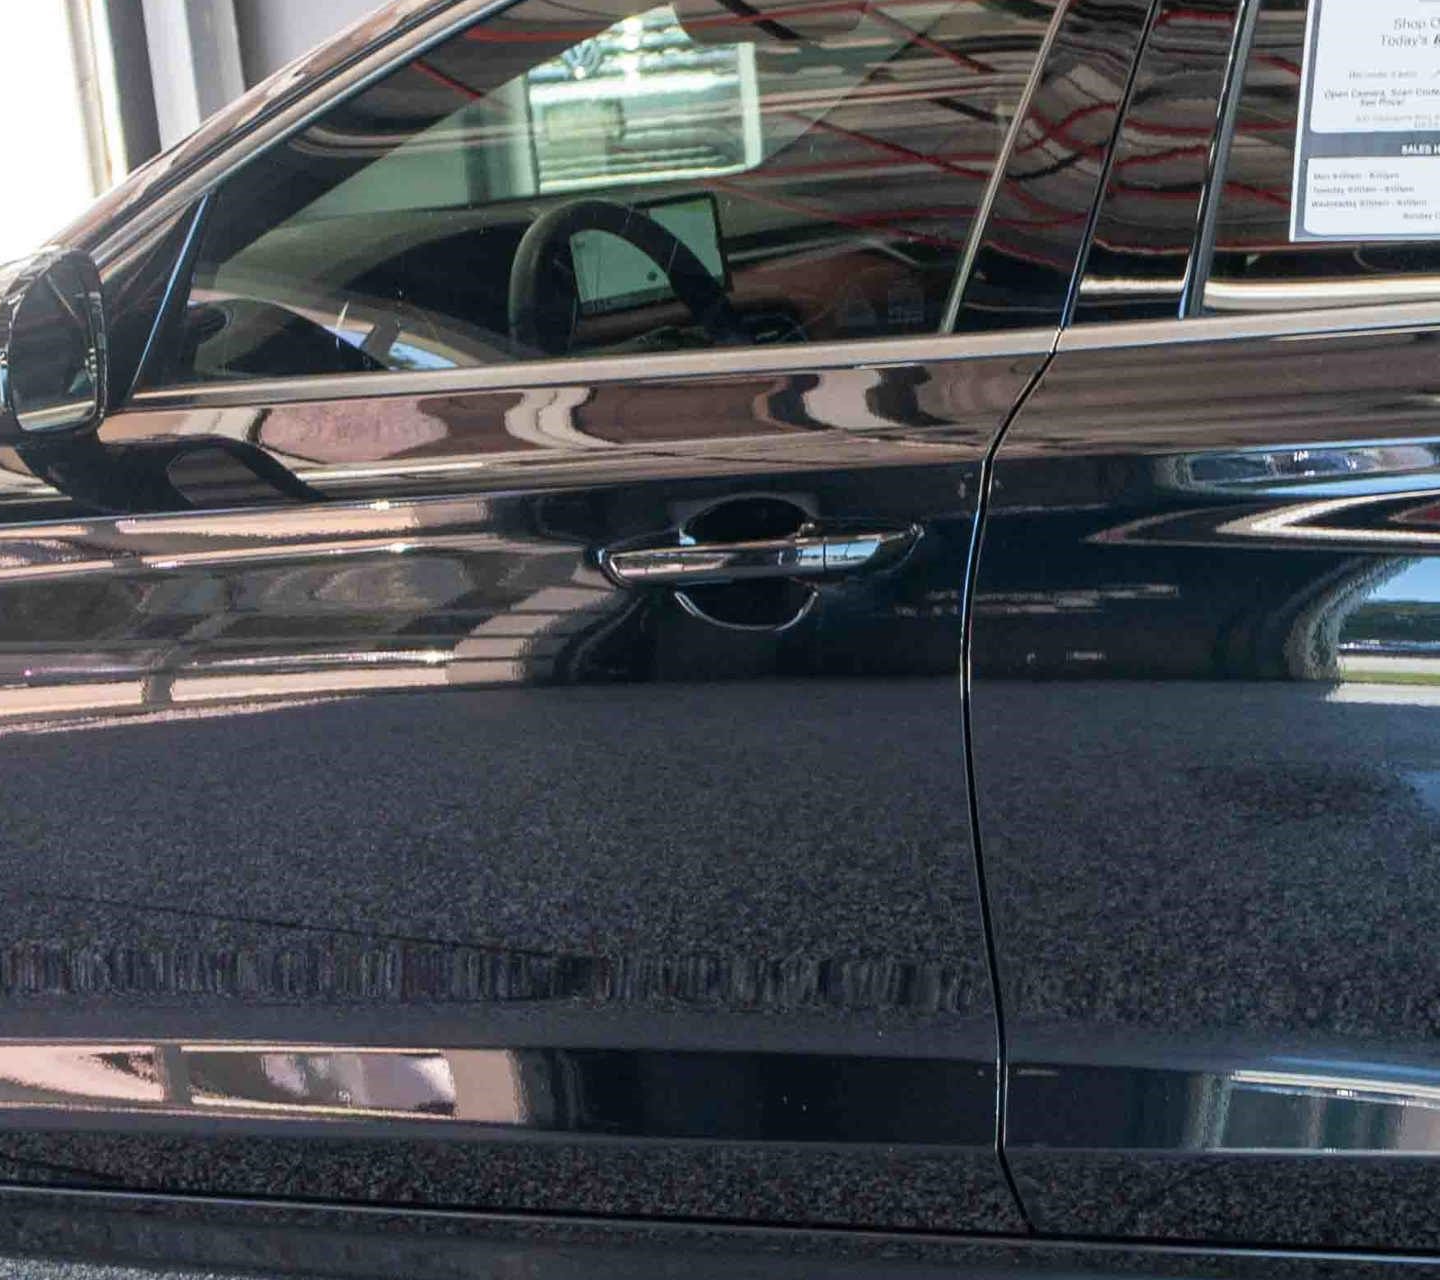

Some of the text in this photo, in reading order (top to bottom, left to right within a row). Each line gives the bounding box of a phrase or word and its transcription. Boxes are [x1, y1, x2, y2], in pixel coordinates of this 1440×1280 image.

[1393, 17, 1426, 31] Shop
[1380, 34, 1428, 48] Today's
[1401, 143, 1432, 156] SALES
